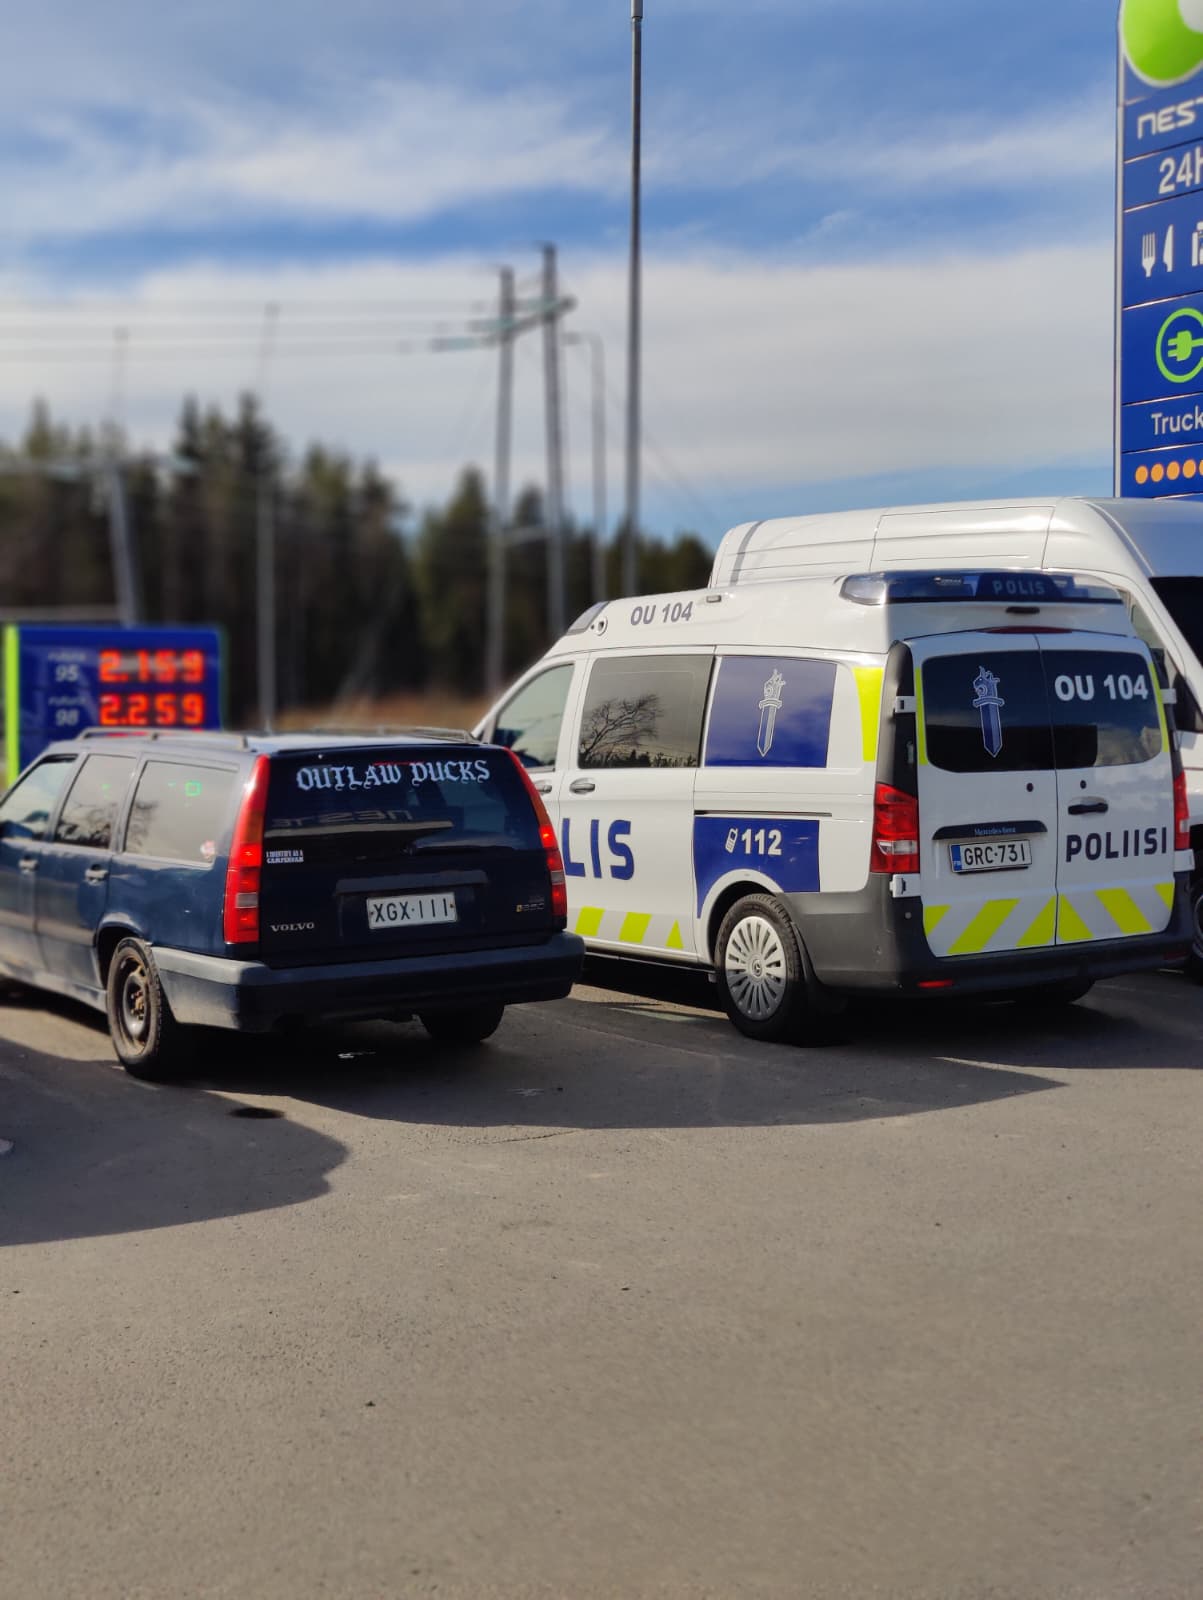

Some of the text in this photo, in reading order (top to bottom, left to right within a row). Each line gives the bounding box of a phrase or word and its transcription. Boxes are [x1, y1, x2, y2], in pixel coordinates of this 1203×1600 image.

[992, 580, 1046, 595] POLIS
[630, 601, 693, 626] OU 104
[1054, 674, 1148, 701] OU 104
[99, 692, 204, 726] 2.259
[296, 760, 491, 792] OUTLAW DUCKS
[741, 828, 782, 856] 112
[964, 843, 1025, 866] GRC-731
[1066, 826, 1168, 863] POLIISI
[270, 921, 315, 932] VOLVO
